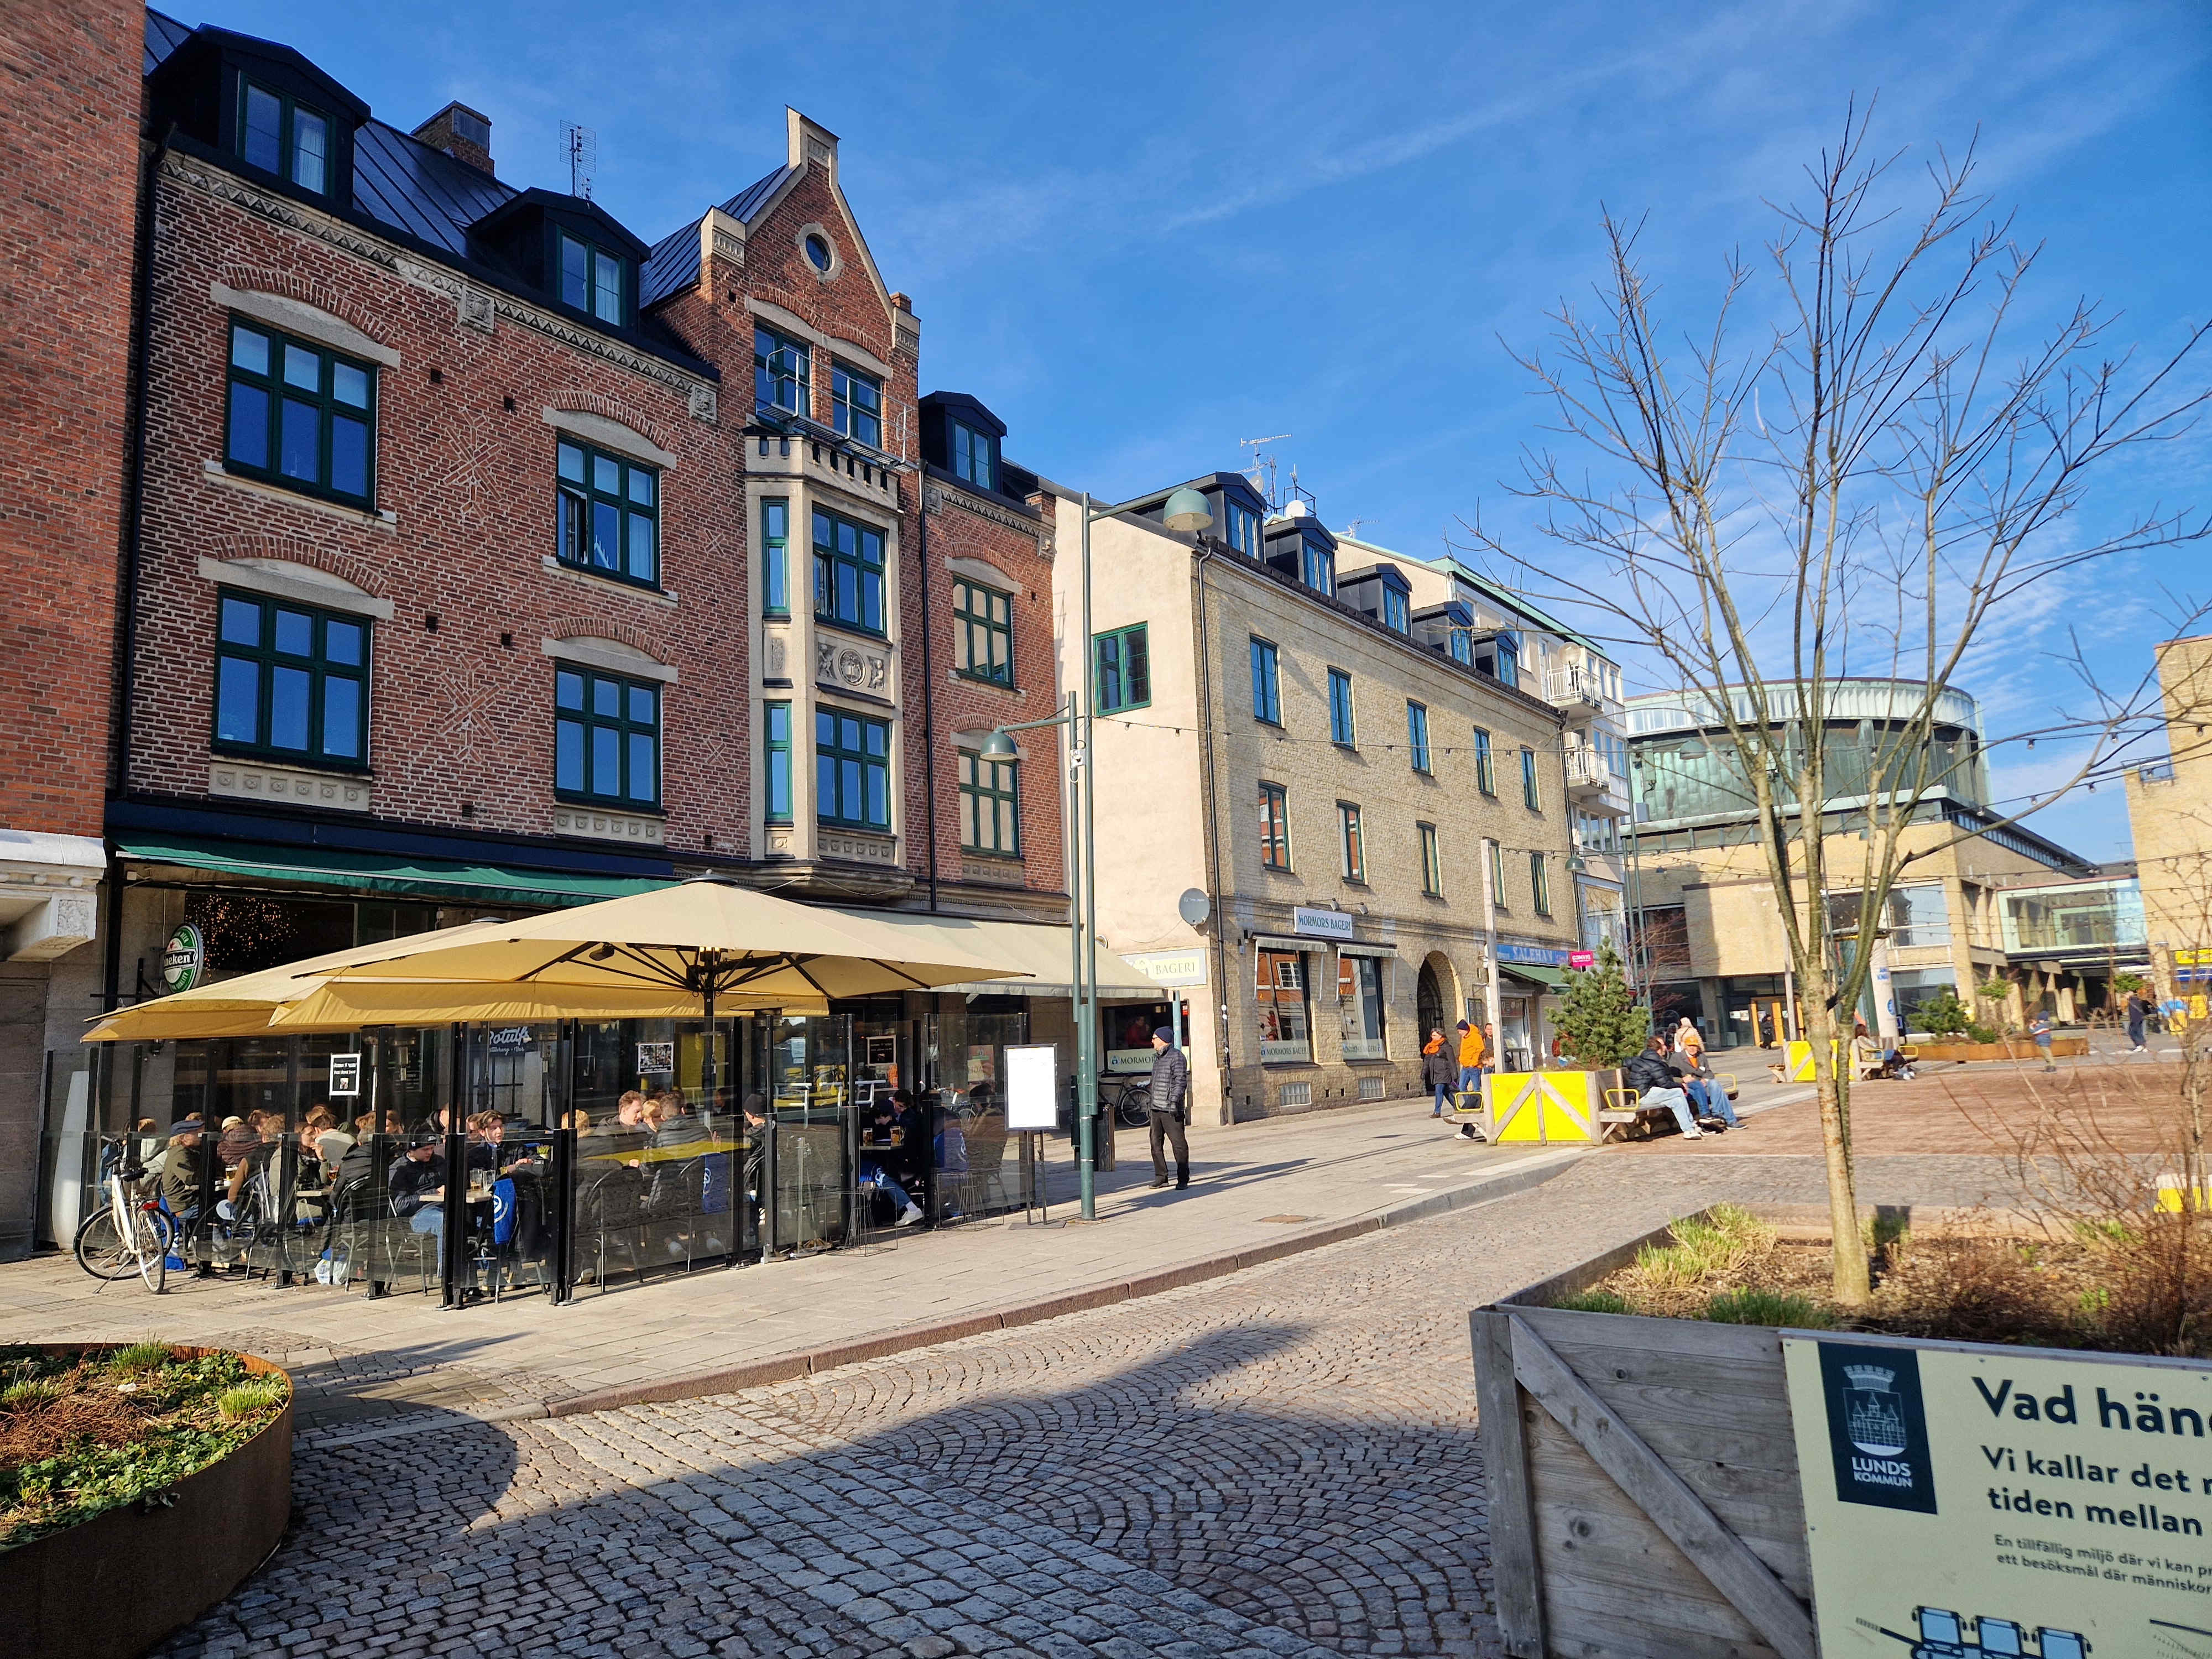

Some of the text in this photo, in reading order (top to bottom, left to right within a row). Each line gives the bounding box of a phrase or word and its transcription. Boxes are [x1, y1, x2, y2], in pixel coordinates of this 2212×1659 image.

[1298, 914, 1351, 931] MORMORS BAGERI
[1155, 961, 1195, 975] BAGERI
[1971, 1376, 2212, 1438] Vad hän
[1851, 1456, 1911, 1477] LUNDS
[1853, 1470, 1913, 1488] KOMMUN
[1980, 1444, 2016, 1472] Vi
[2025, 1450, 2120, 1484] kallar
[2131, 1463, 2192, 1494] det
[1987, 1486, 2203, 1537] tiden mellan
[1994, 1533, 2013, 1547] En
[2016, 1537, 2073, 1560] tillfällig
[2077, 1548, 2115, 1564] miljö
[2119, 1552, 2143, 1567] där
[2147, 1557, 2161, 1569] vi
[2165, 1558, 2194, 1574] kan
[1996, 1554, 2212, 1595] ett besöksmål där människor
